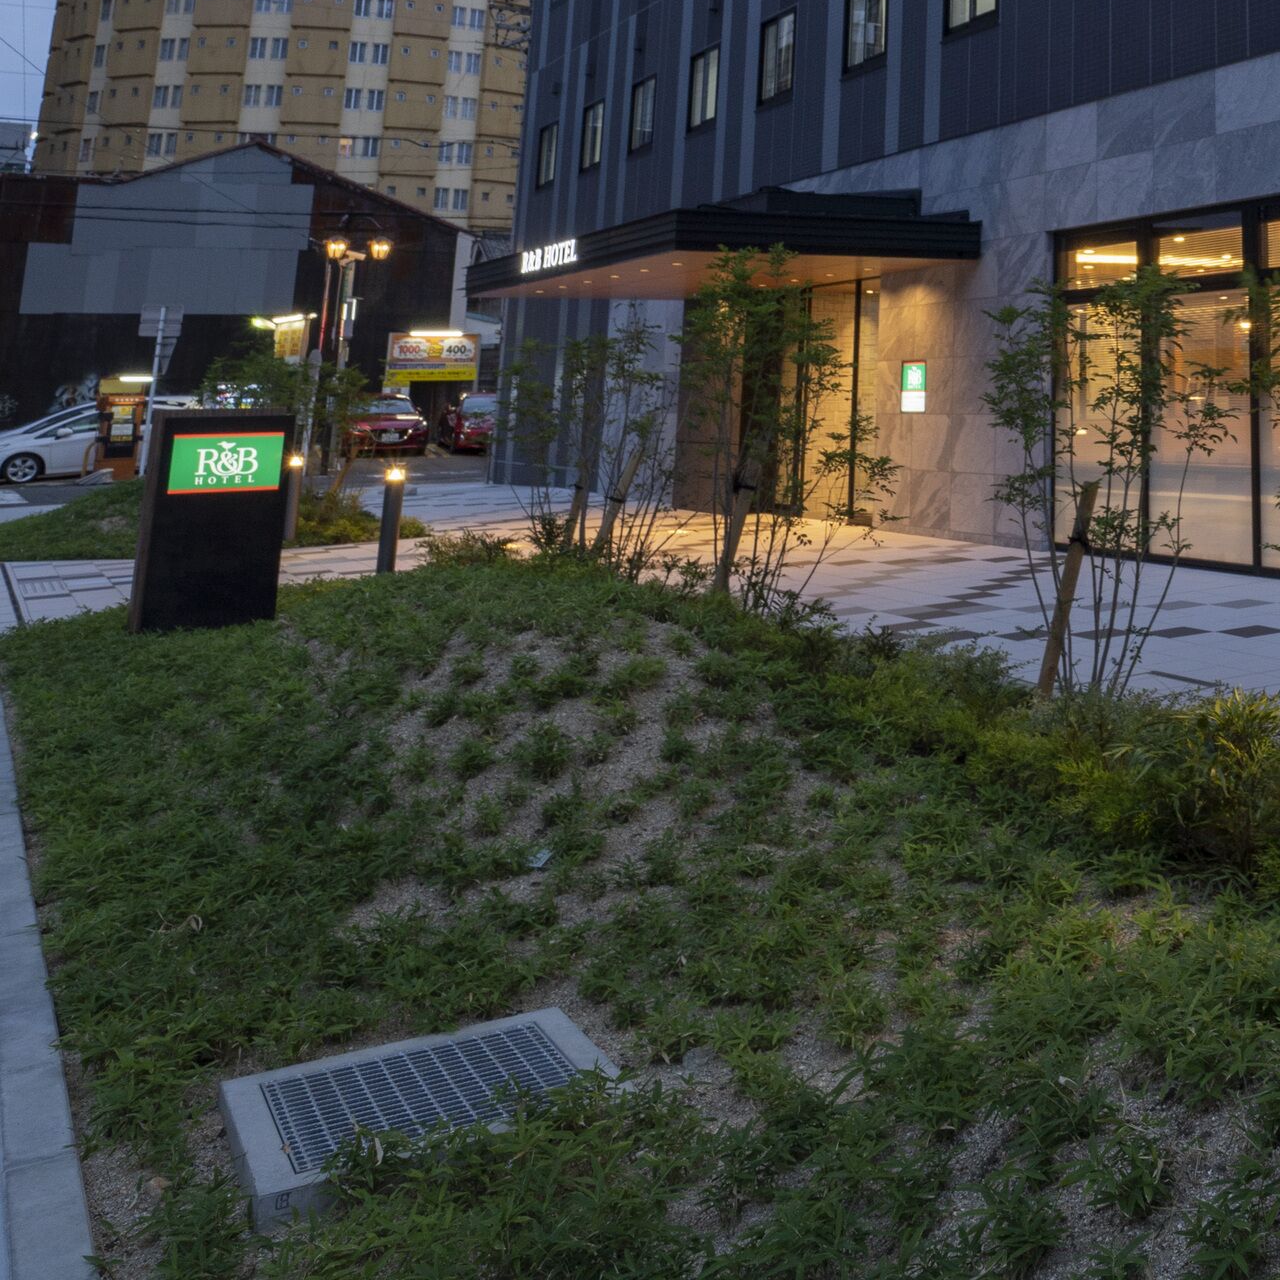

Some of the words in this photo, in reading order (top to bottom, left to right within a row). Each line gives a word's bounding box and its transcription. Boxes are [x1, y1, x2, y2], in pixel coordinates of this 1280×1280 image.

[521, 248, 542, 273] R&B
[543, 239, 577, 269] HOTEL
[194, 447, 259, 476] R&B
[194, 474, 255, 486] HOTEL
